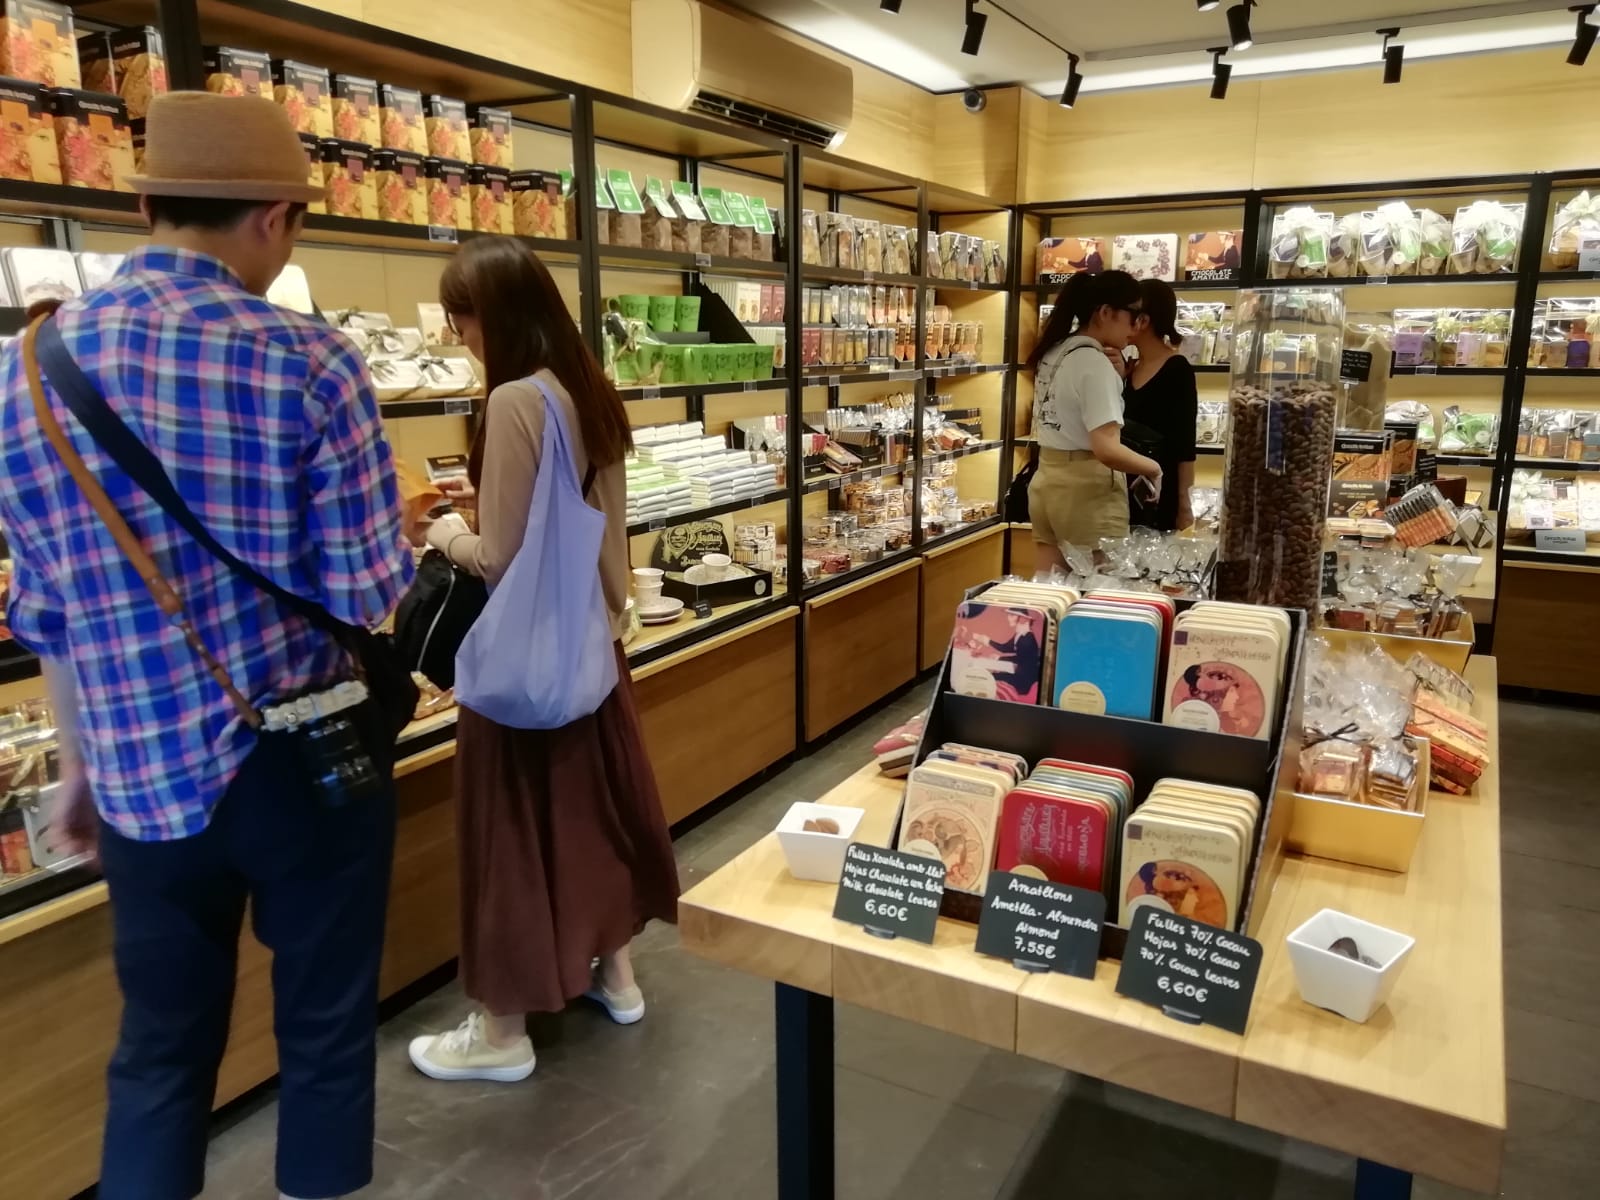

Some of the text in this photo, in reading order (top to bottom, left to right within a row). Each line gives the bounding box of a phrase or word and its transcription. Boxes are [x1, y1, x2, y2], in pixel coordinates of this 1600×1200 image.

[1191, 269, 1232, 277] CHOCOLATE
[845, 862, 867, 877] Hojas
[865, 898, 908, 921] 6,60€
[1015, 921, 1060, 940] Almond
[1147, 913, 1185, 935] Fulles
[1191, 925, 1213, 945] 70%
[1014, 936, 1056, 959] 7,55€
[1144, 930, 1240, 970] Hojas 70% Cacao
[1140, 947, 1165, 966] 70%
[1204, 969, 1240, 990] Leaves
[1157, 976, 1208, 1003] 6,60€
